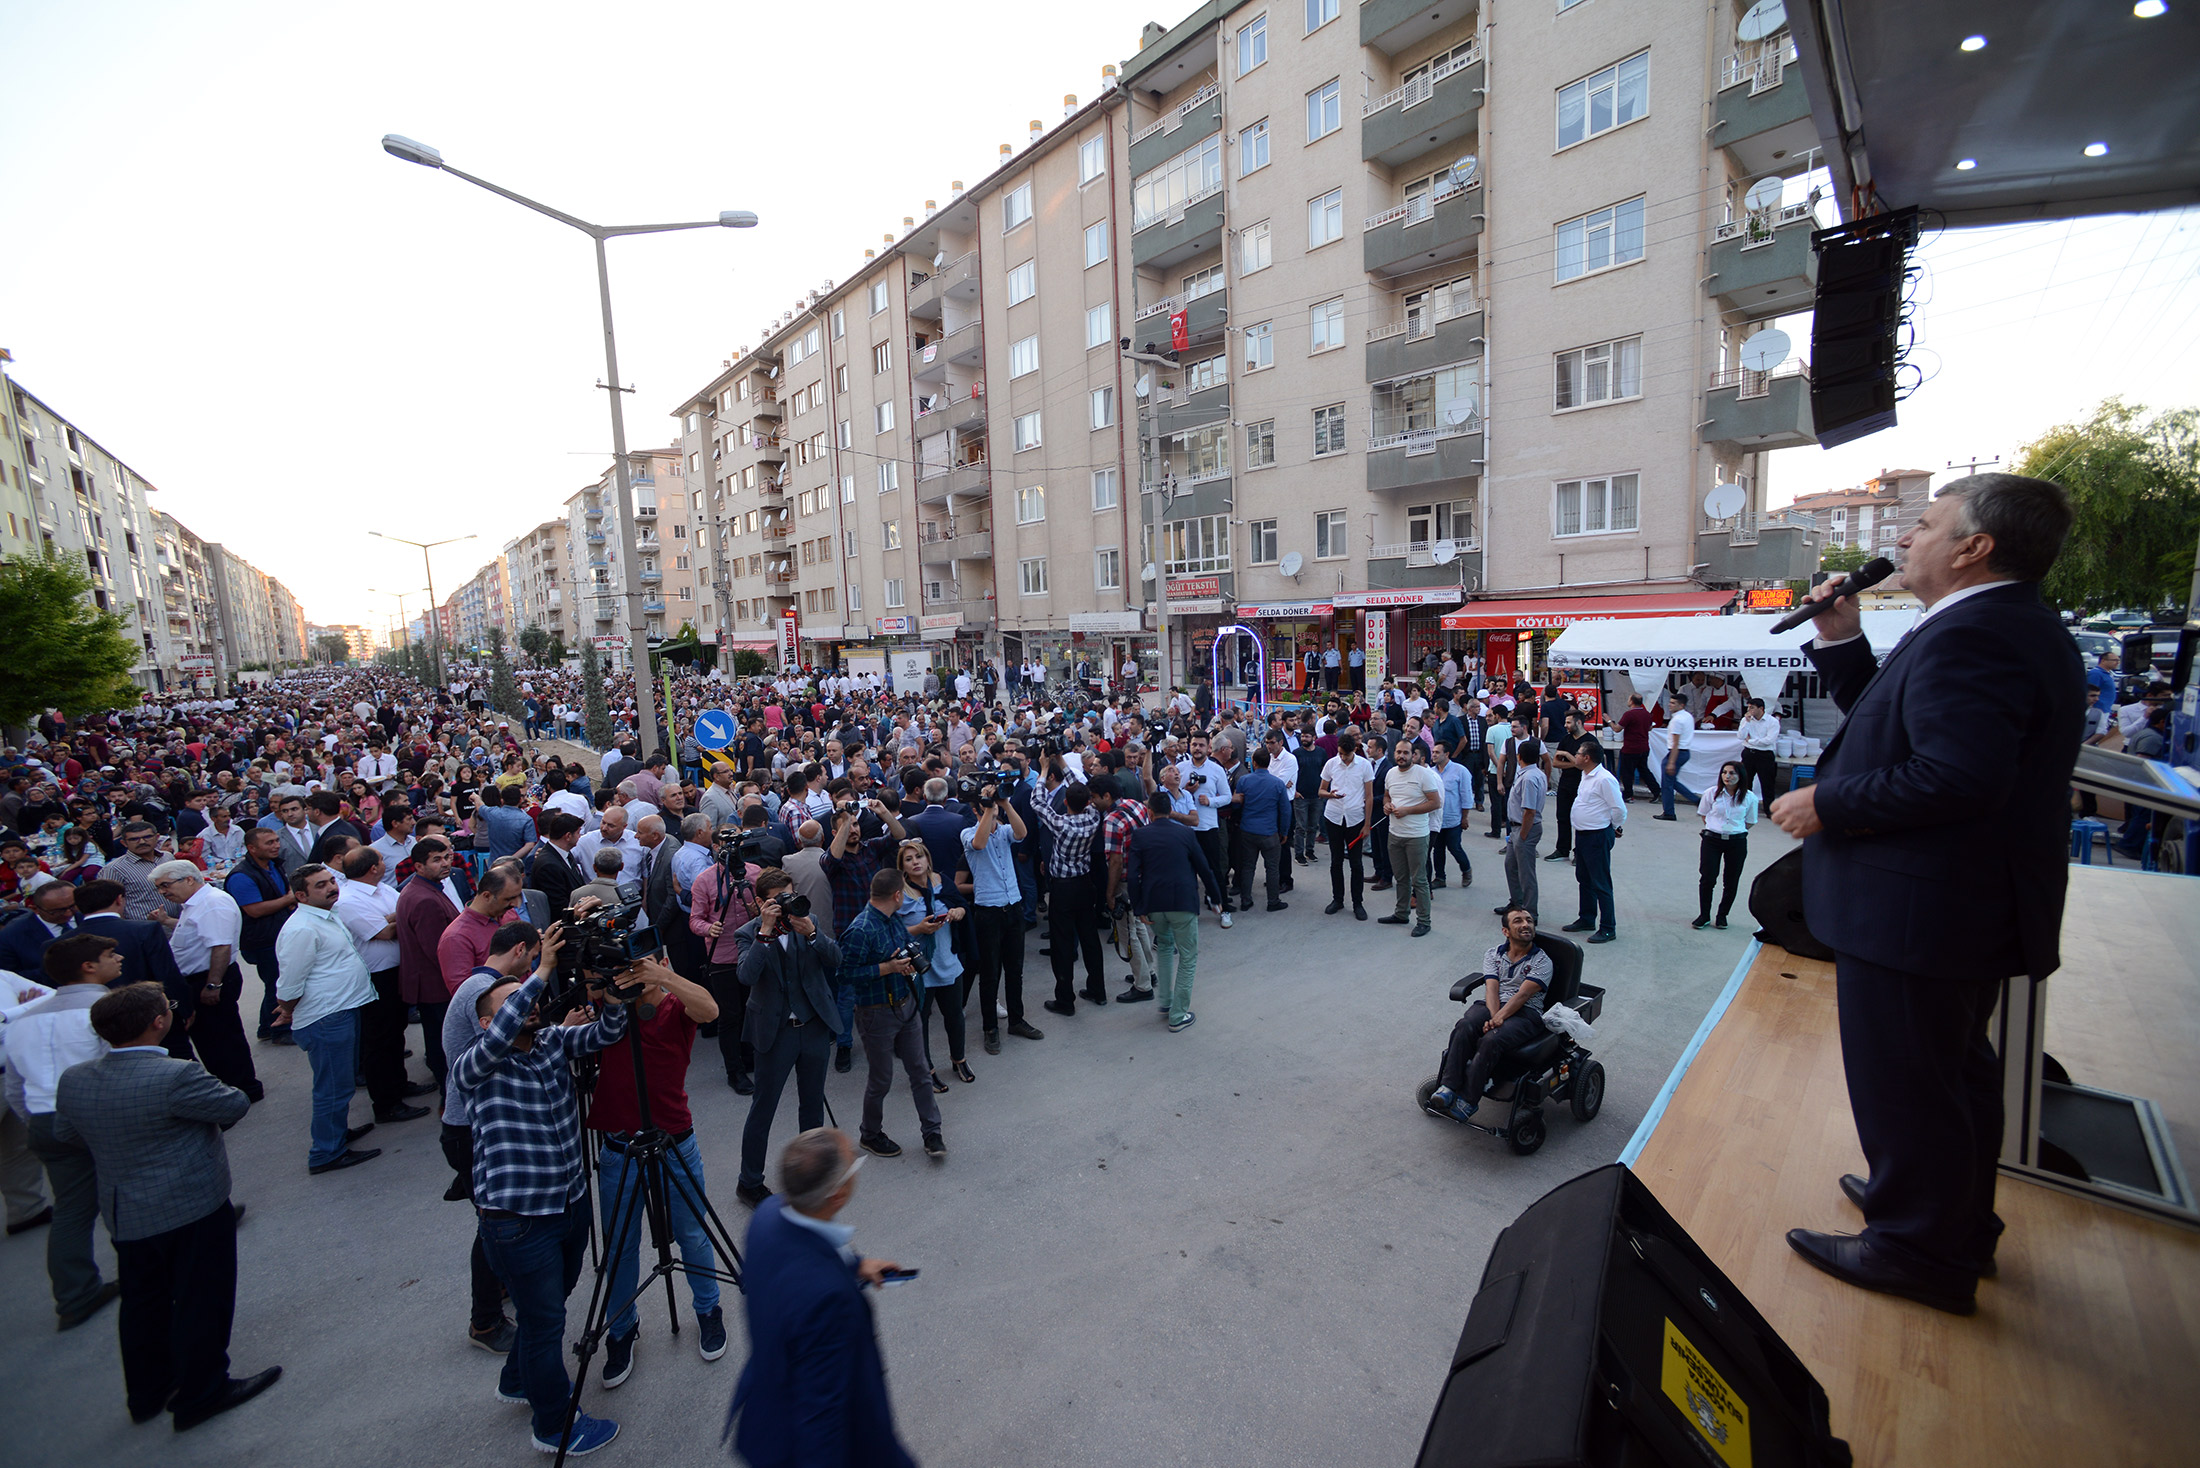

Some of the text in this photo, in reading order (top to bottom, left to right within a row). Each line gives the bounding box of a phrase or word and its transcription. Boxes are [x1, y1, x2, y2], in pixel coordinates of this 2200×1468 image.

[1187, 580, 1217, 590] TEKSTİL
[1366, 595, 1392, 605] SELDA
[1393, 593, 1424, 604] DÖNER
[1174, 605, 1198, 613] TEKSTİL
[1258, 607, 1281, 616] SELDA
[1282, 606, 1309, 616] DÖNER
[1516, 616, 1576, 627] KÖYLÜM
[783, 621, 796, 665] halkpazarı
[1581, 655, 1808, 669] KONYA BÜYÜKŞEHİR BELEDİ
[1687, 1367, 1725, 1415] KONYA
